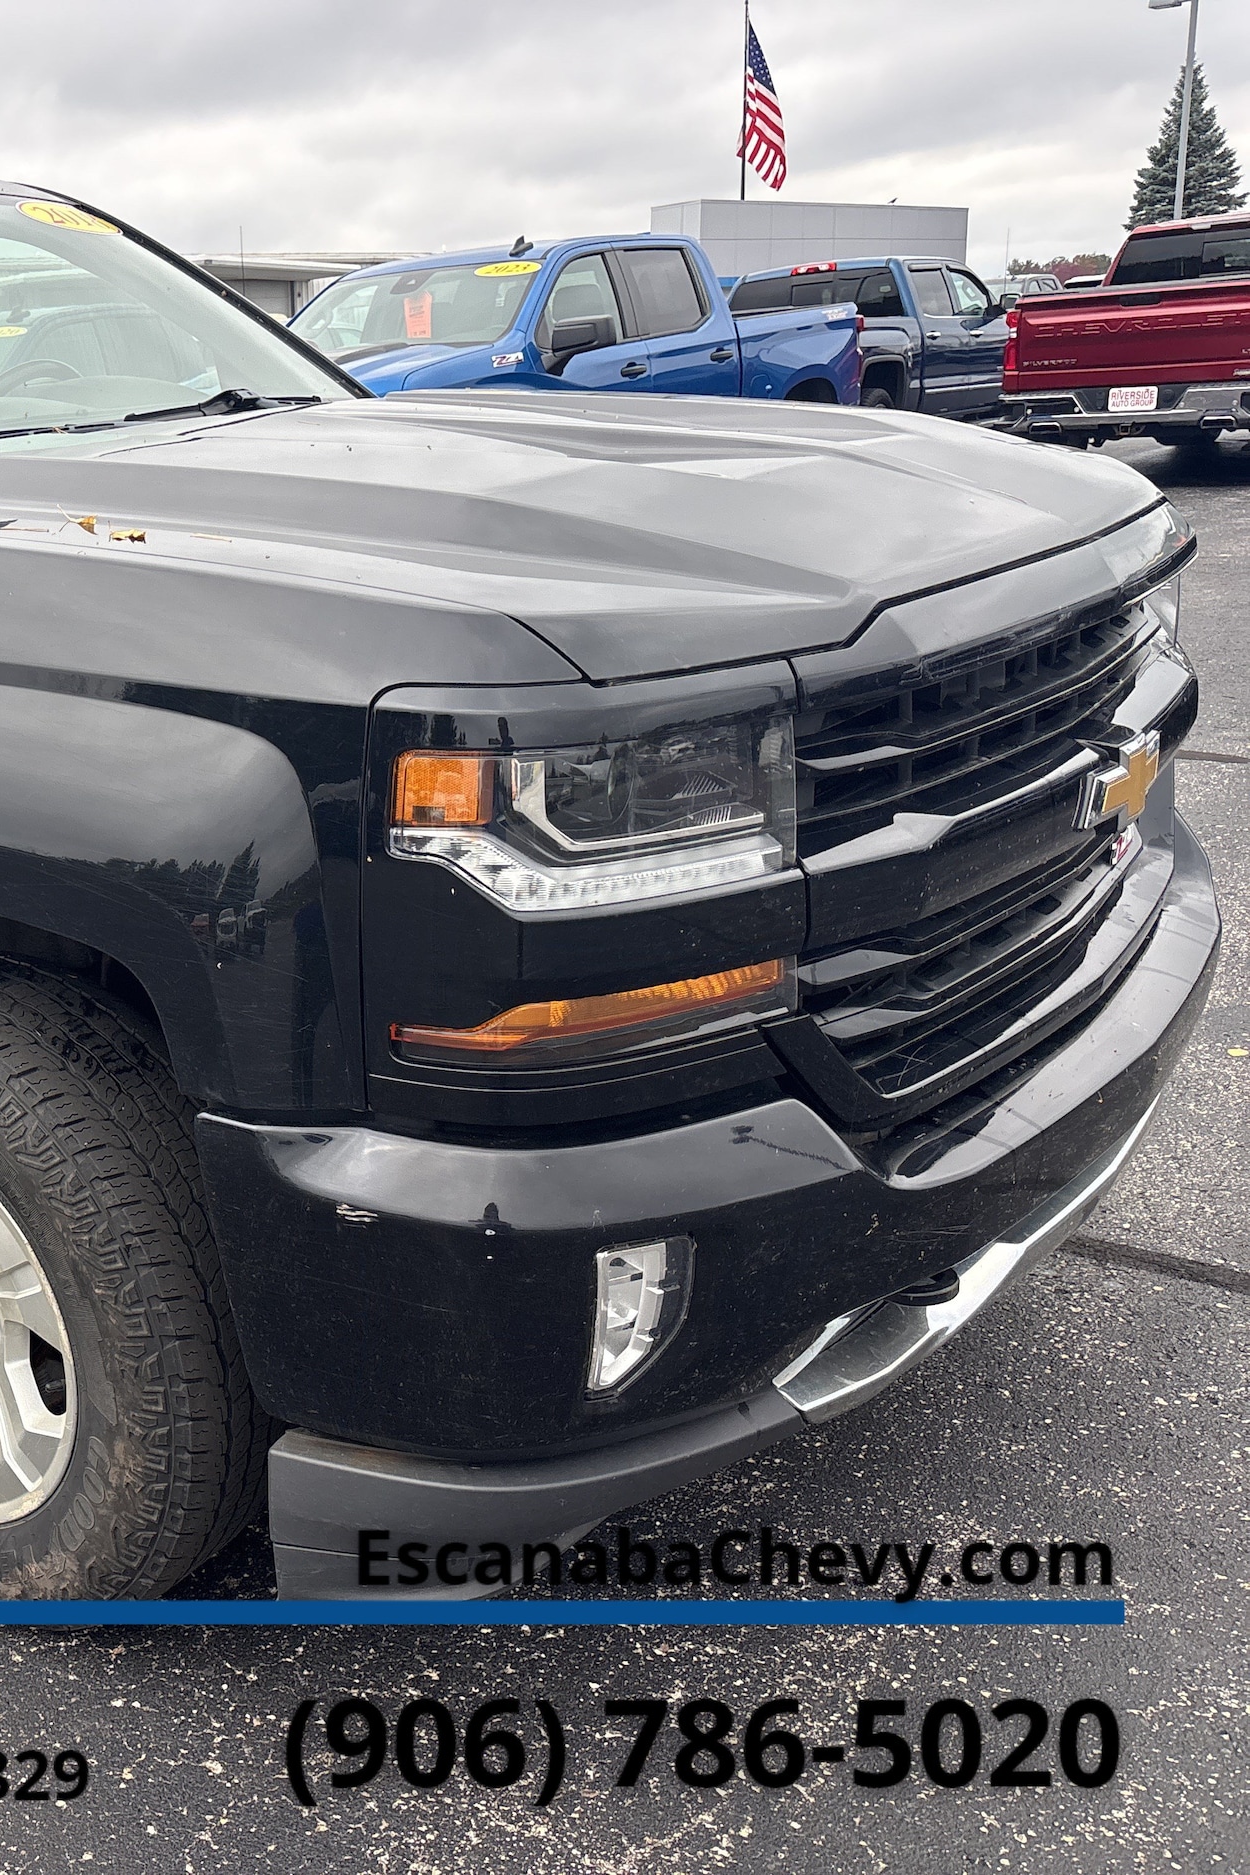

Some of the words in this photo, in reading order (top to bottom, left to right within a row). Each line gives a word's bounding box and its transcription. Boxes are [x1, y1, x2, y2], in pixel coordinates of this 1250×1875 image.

[482, 262, 532, 275] 2023
[1110, 388, 1156, 400] RIVERSIDE
[1110, 400, 1129, 408] AUTO
[1130, 399, 1154, 407] GROUP
